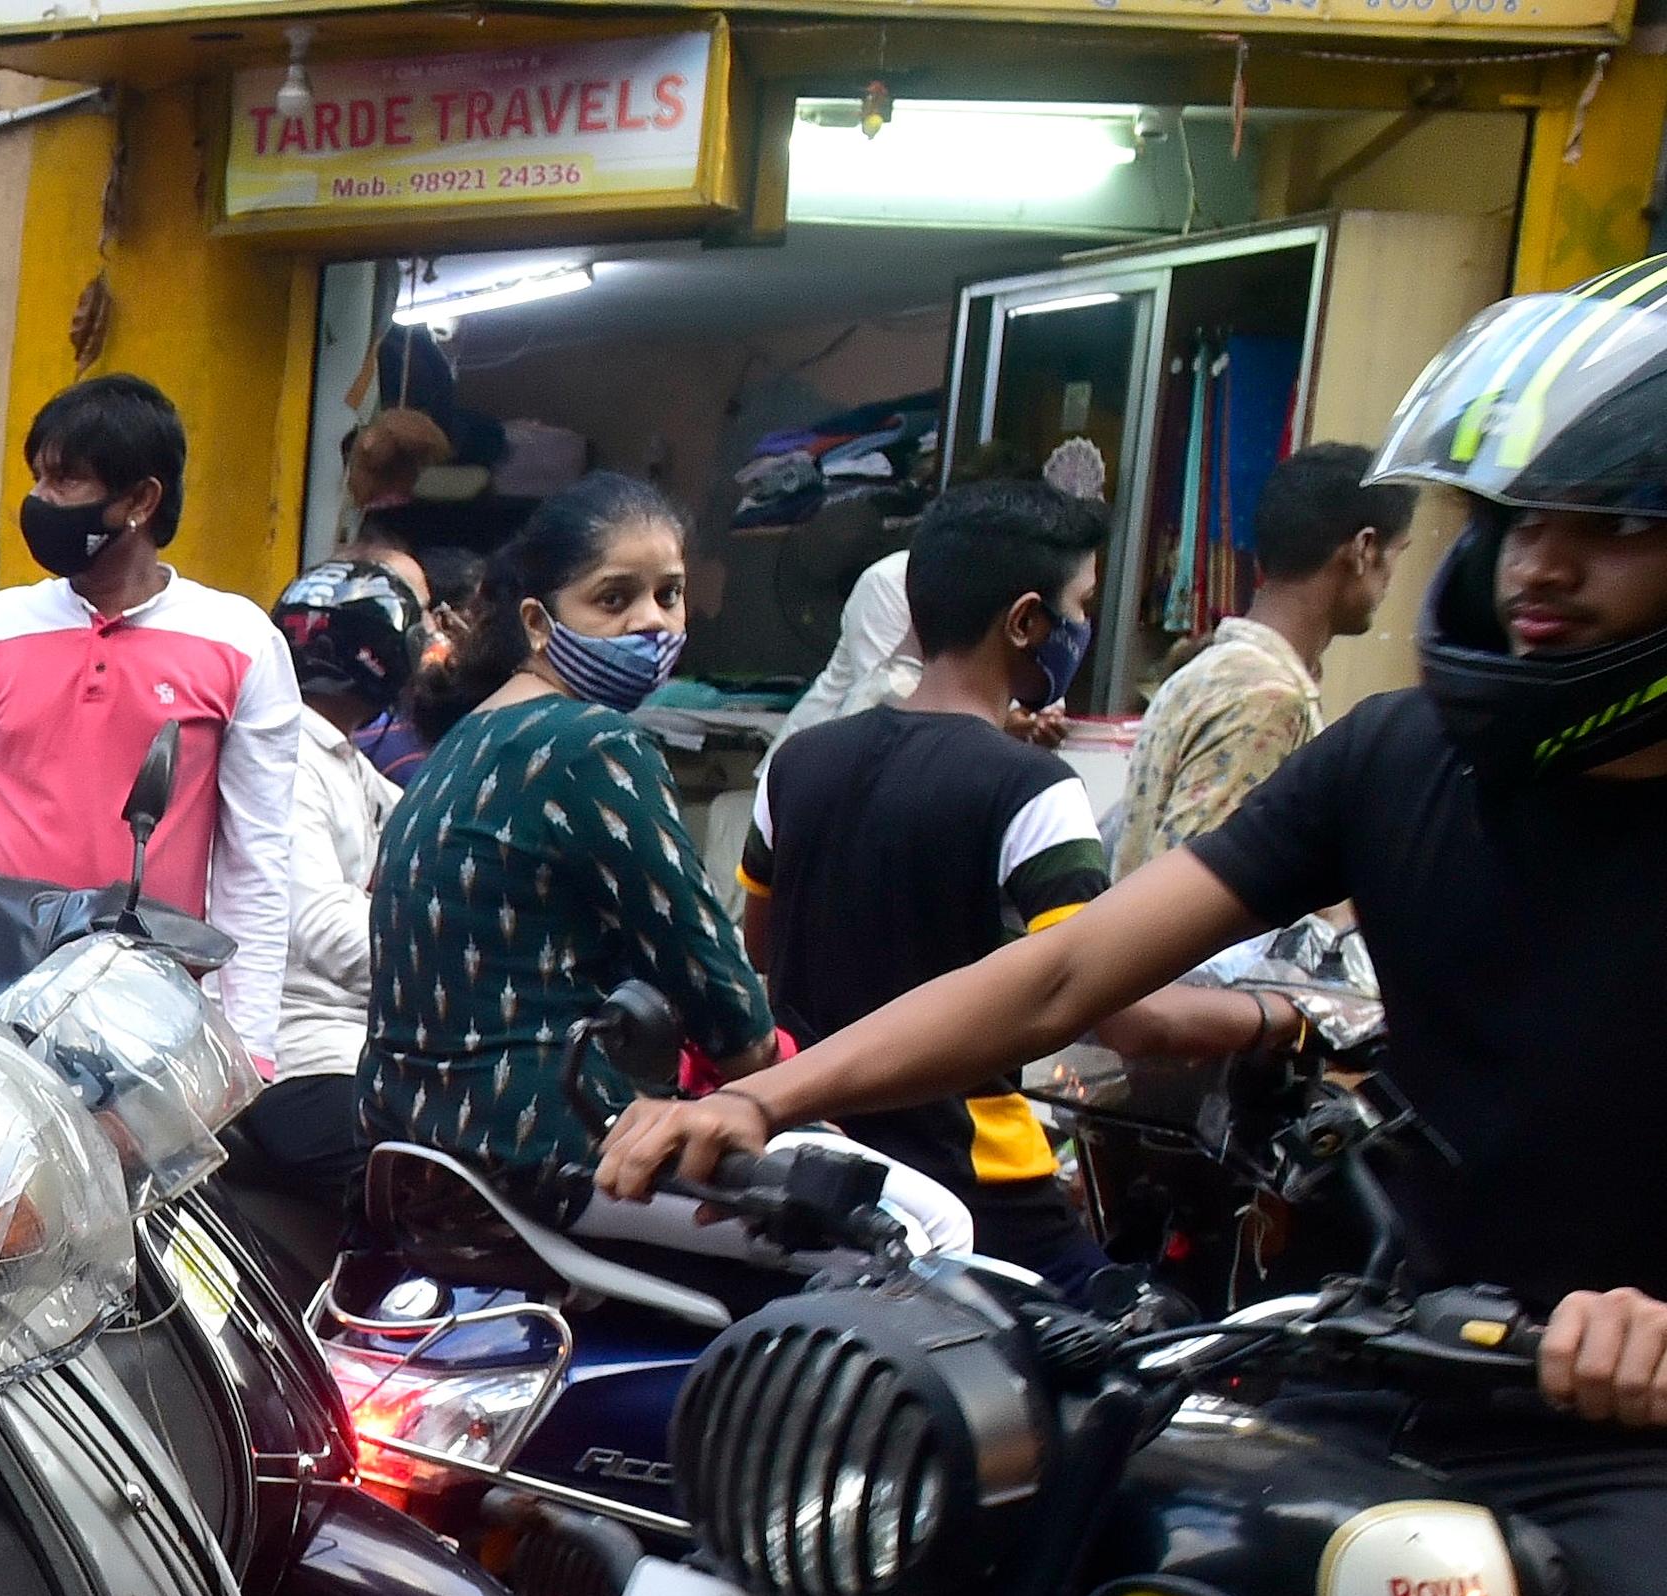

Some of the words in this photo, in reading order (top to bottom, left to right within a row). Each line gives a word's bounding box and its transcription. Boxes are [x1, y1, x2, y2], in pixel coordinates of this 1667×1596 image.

[249, 95, 413, 155] TARDE
[431, 73, 689, 143] TRAVELS
[409, 167, 486, 193] 98921
[497, 163, 581, 189] 24336
